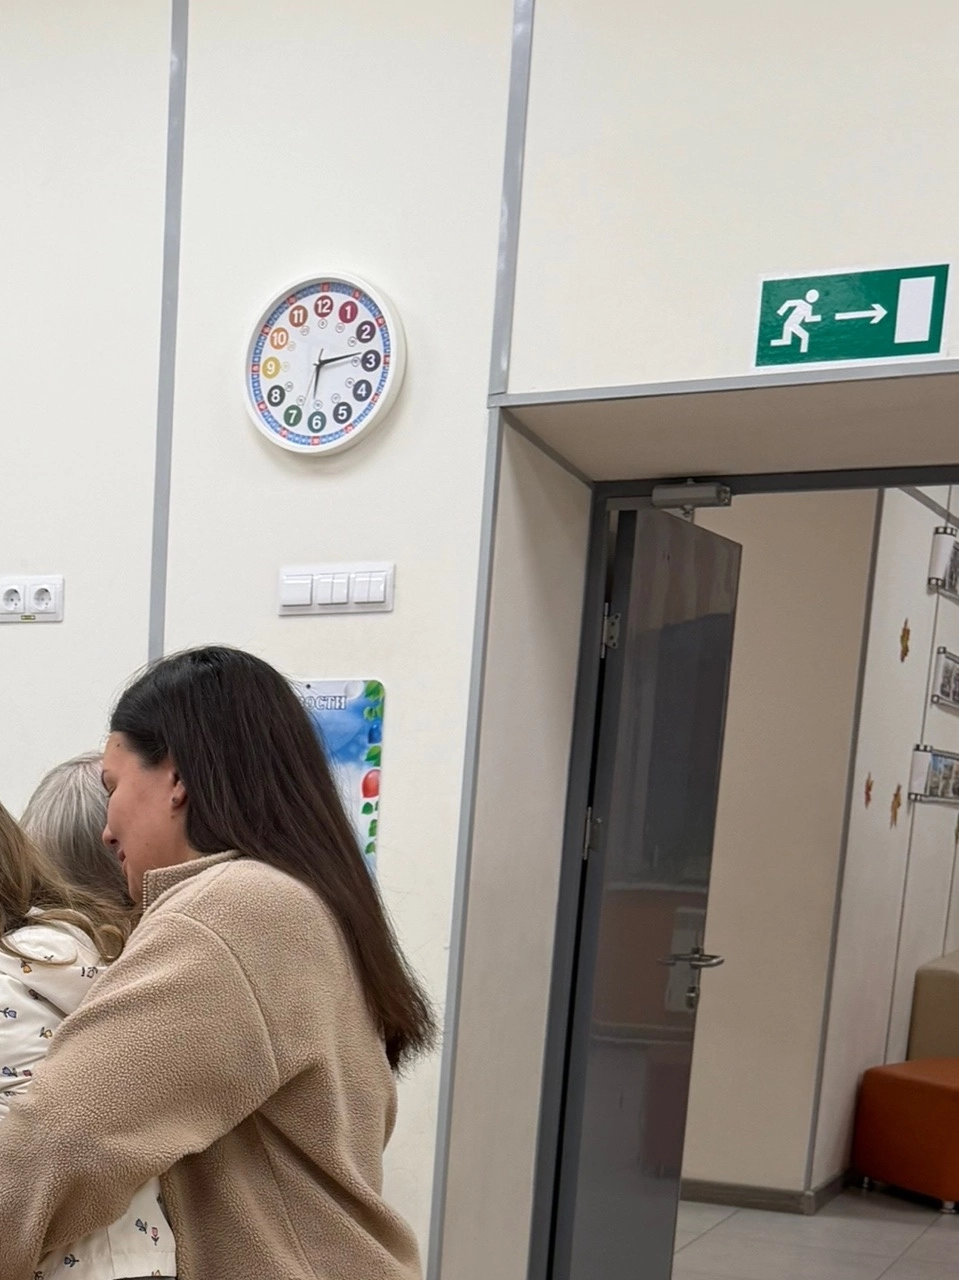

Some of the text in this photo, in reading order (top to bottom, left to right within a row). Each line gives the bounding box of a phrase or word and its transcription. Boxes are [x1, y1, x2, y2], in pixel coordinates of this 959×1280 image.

[316, 298, 331, 314] 12
[292, 309, 304, 324] 11
[271, 330, 287, 347] 10
[360, 324, 371, 339] 2
[266, 360, 276, 375] 9
[365, 353, 376, 369] 3
[270, 388, 281, 403] 8
[356, 382, 368, 398] 4
[288, 409, 298, 424] 7
[337, 405, 348, 421] 5
[311, 414, 322, 430] 6
